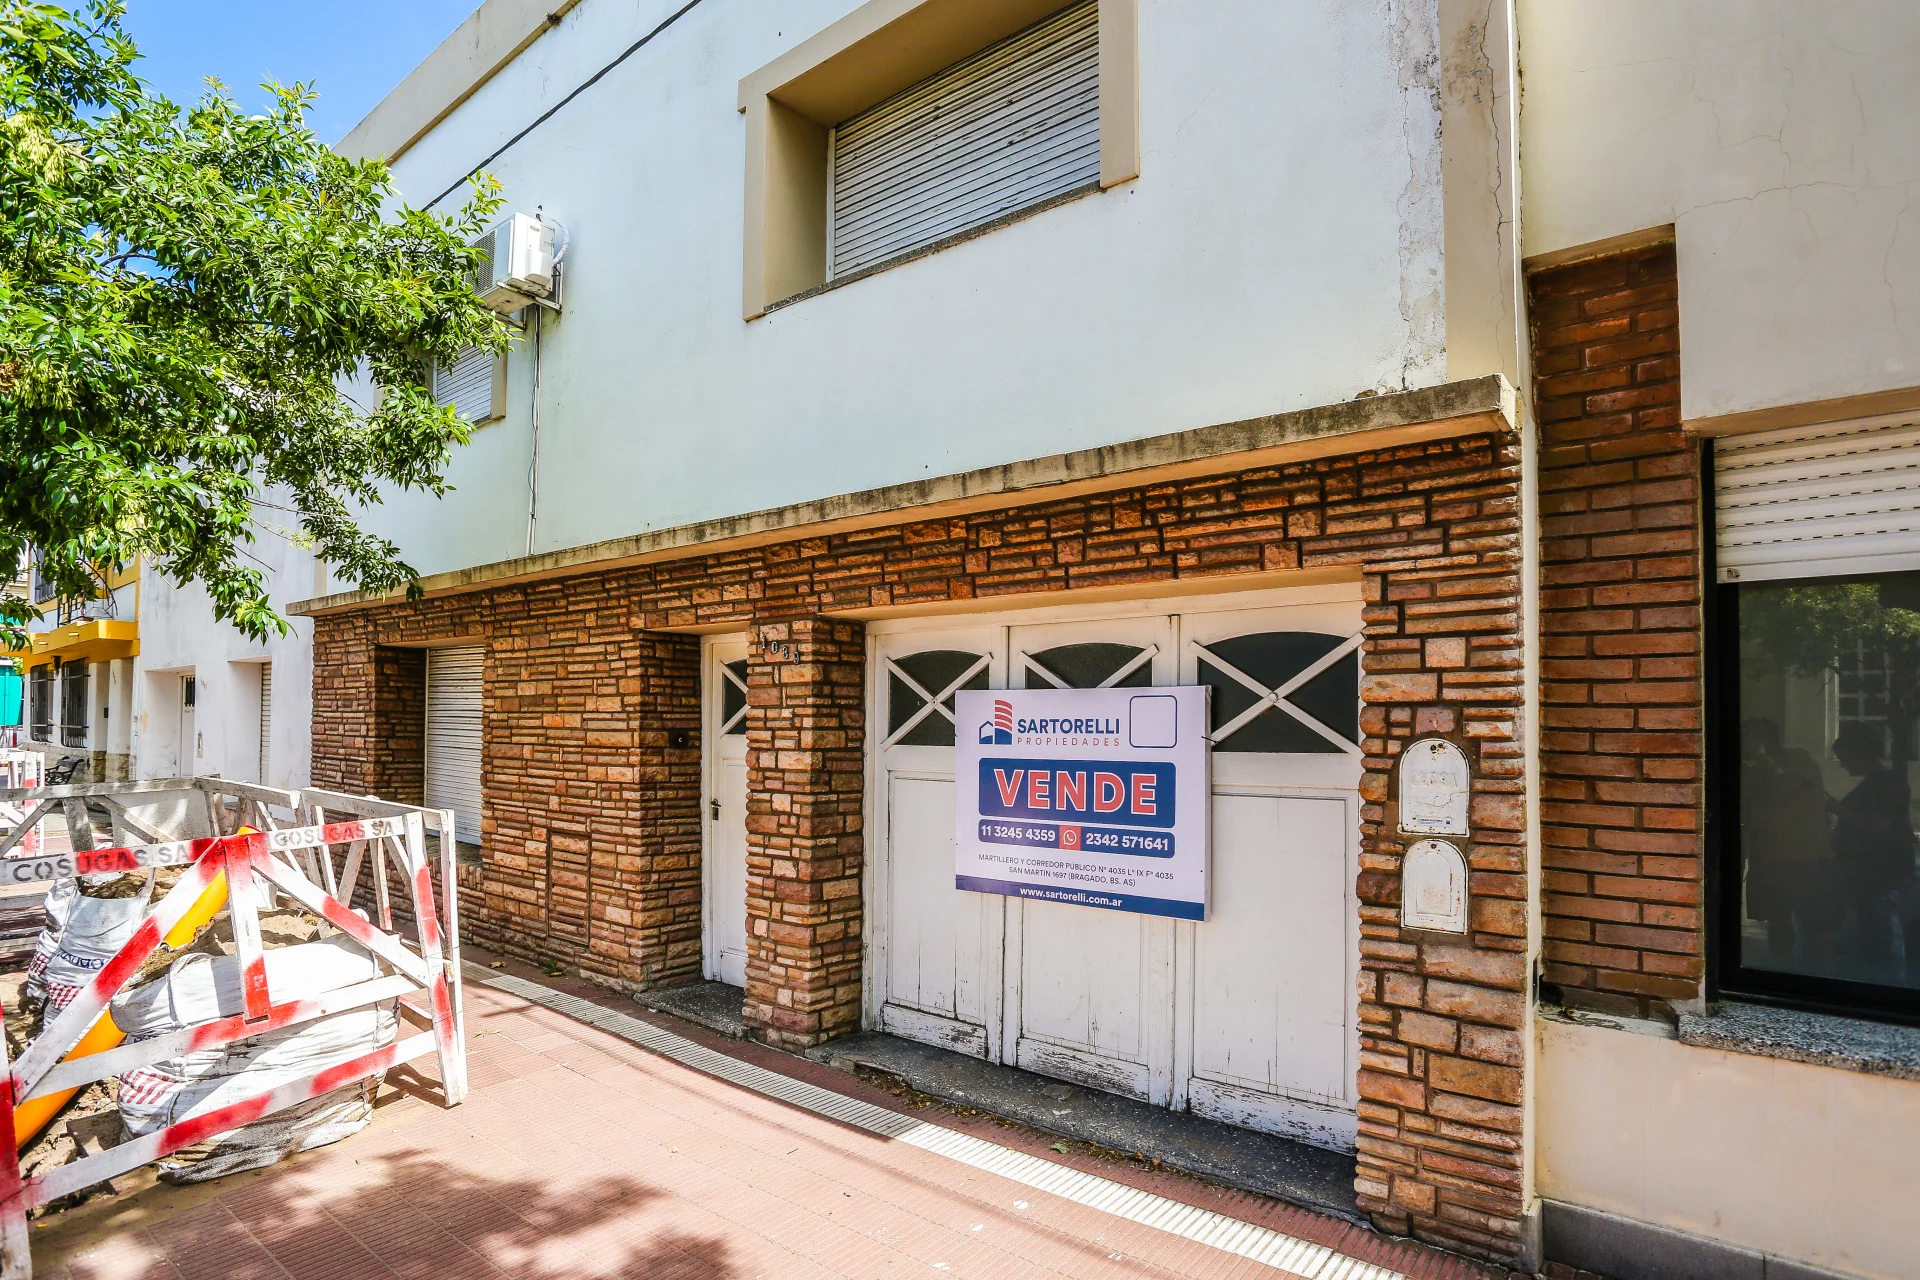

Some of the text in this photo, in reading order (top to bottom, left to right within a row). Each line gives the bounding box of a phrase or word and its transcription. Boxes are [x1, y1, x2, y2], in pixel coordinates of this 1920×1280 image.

[1017, 718, 1120, 734] SARTORELLI
[1017, 737, 1120, 747] PROPIEDADES
[993, 768, 1157, 816] VENDE
[371, 820, 394, 836] SA
[981, 825, 1056, 842] 11 3245 4359
[1085, 833, 1169, 851] 2342 571641
[12, 844, 191, 882] COSUGAS SA
[978, 853, 1019, 865] MARTILLERO
[1026, 858, 1065, 869] CORREDOR
[1065, 862, 1097, 872] PÚBLICO
[1108, 867, 1126, 875] 4035
[1136, 869, 1144, 877] IX
[1155, 871, 1174, 880] 4035
[1008, 866, 1023, 875] SAN
[1023, 868, 1051, 877] MARTÍN
[1052, 871, 1067, 879] 1697
[1122, 878, 1136, 887] AS)
[1019, 887, 1123, 907] www.sartorelli.com.ar
